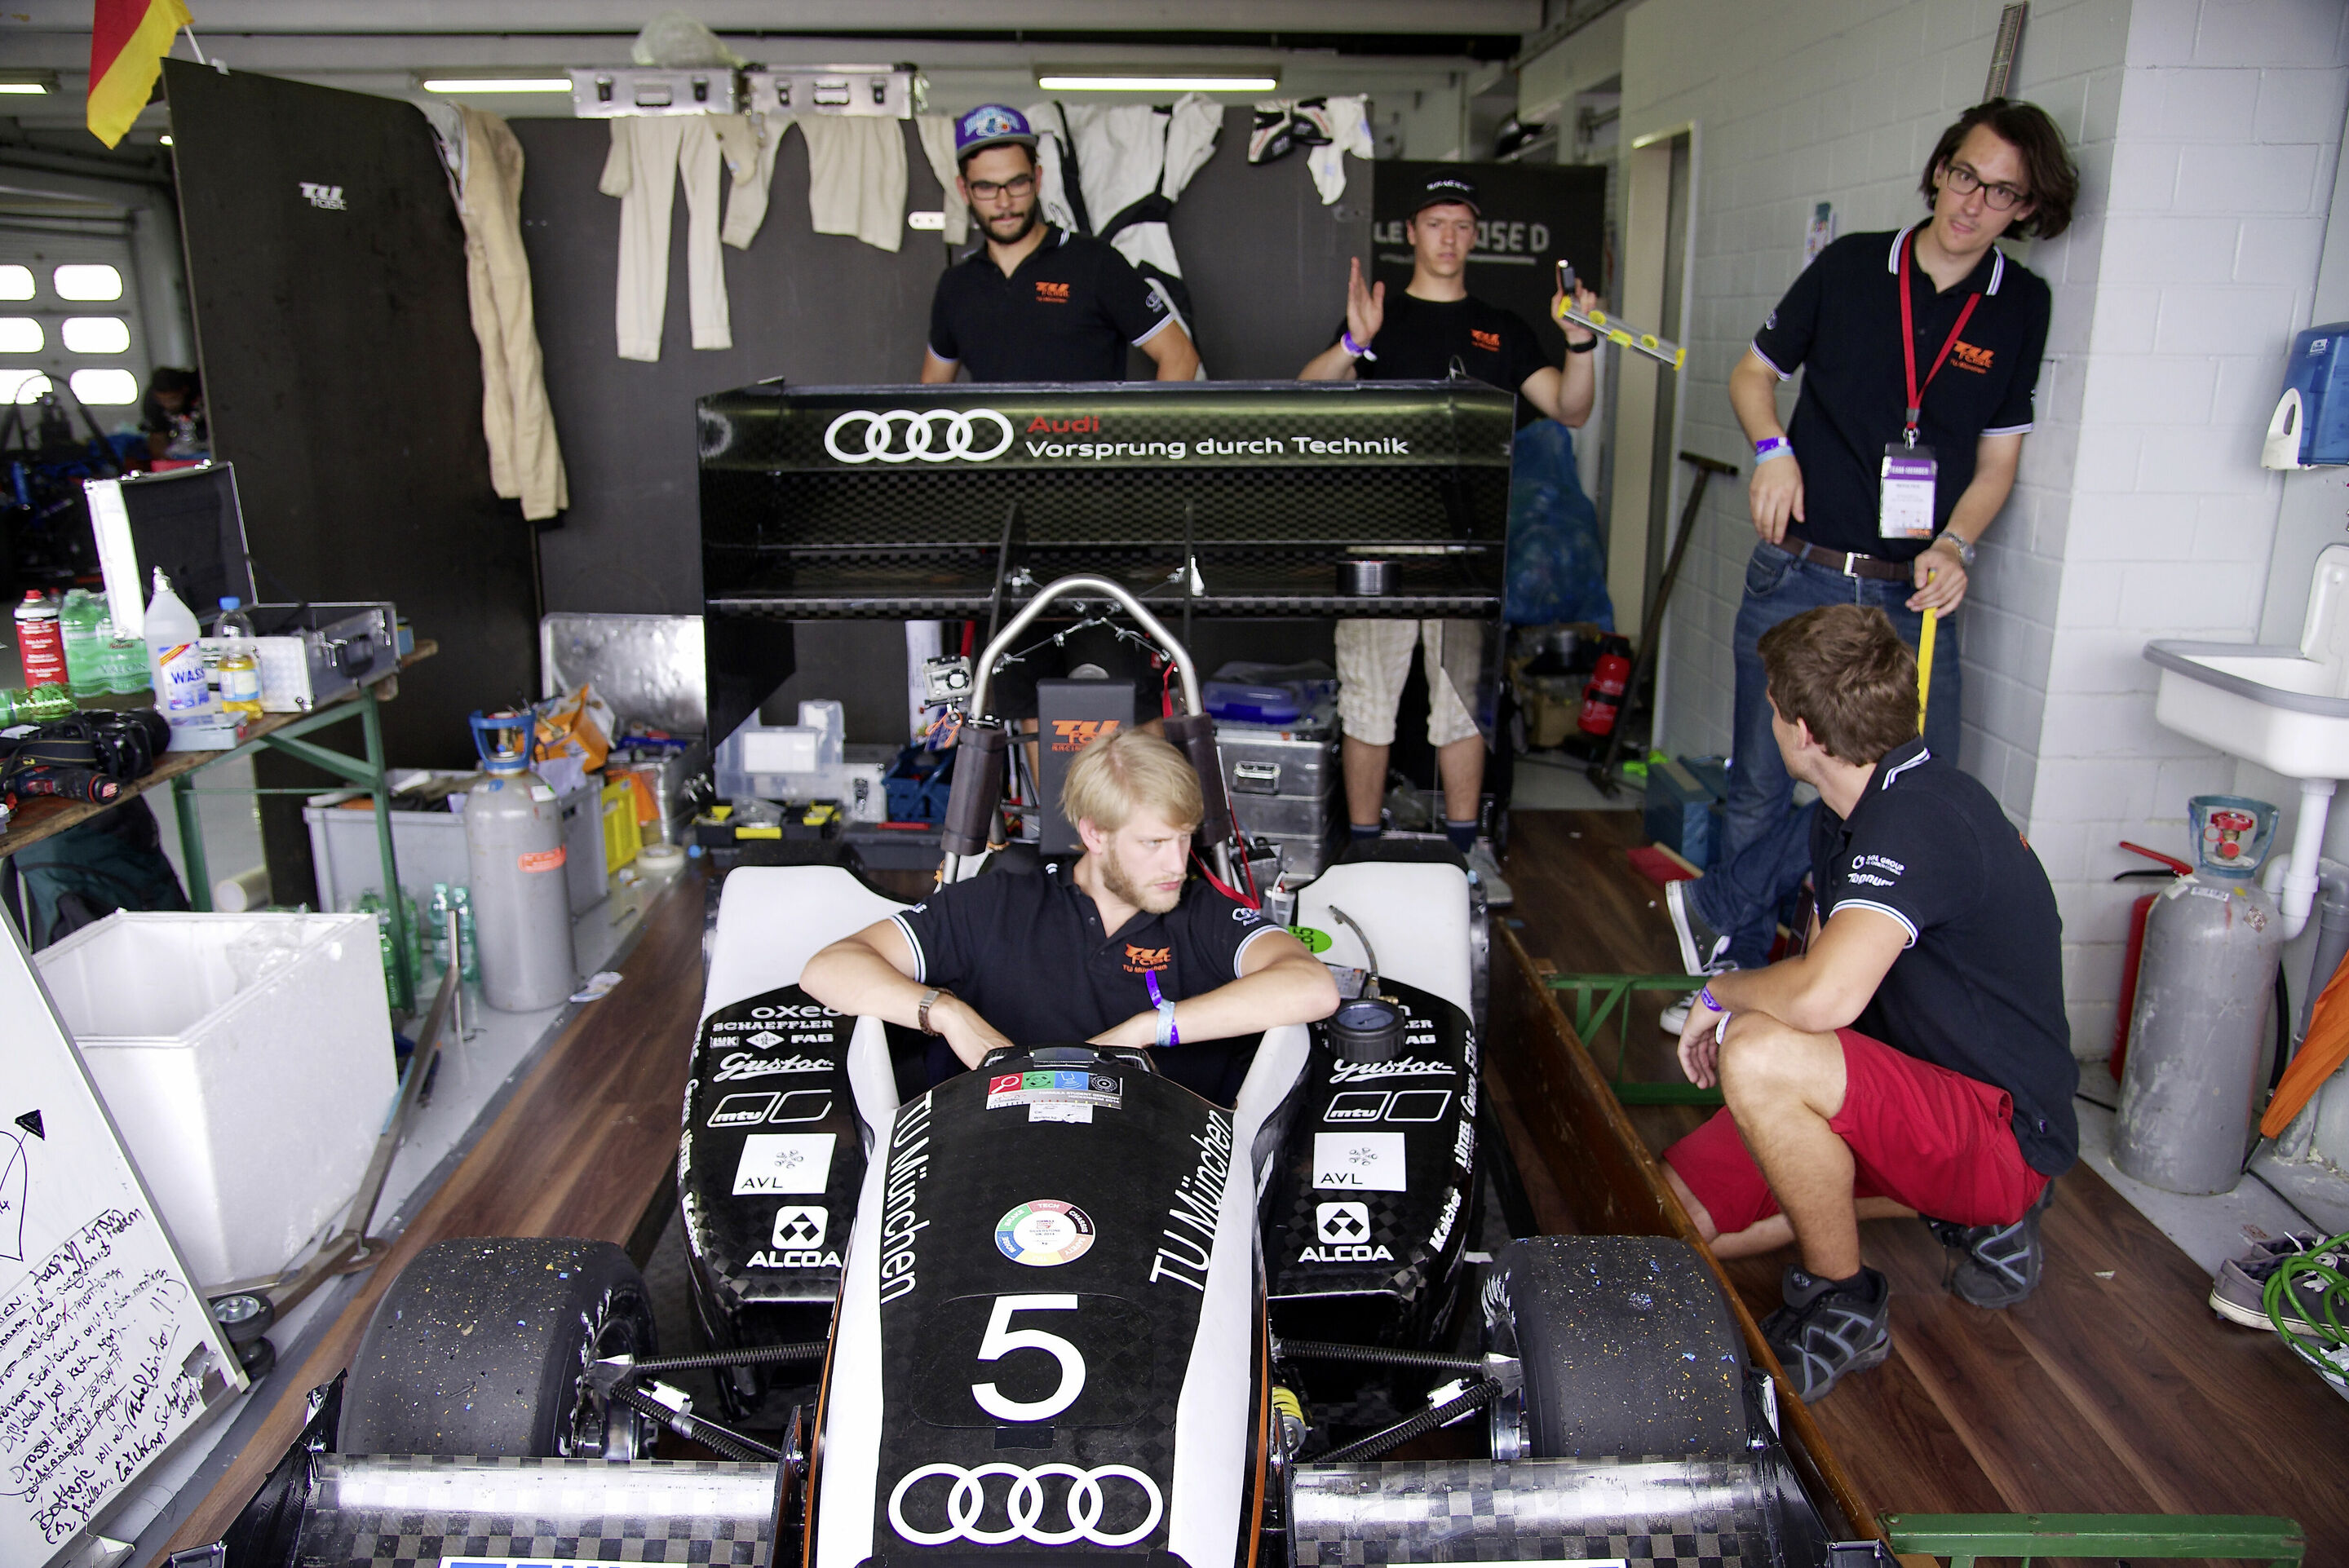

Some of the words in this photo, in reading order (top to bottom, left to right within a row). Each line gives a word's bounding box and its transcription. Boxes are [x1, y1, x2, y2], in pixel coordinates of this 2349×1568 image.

[1027, 414, 1100, 435] Audi
[1025, 439, 1187, 461] Vorsprung
[1198, 436, 1282, 456] durch
[1291, 435, 1410, 455] Technik
[1051, 720, 1120, 735] TU
[712, 1020, 834, 1032] SCHAEFFLER
[790, 1033, 834, 1044] FAG
[1405, 1035, 1436, 1045] AG
[714, 1111, 763, 1122] mtu
[894, 1090, 932, 1149] TU
[1329, 1109, 1378, 1118] mtu
[741, 1177, 784, 1189] AVL
[1169, 1110, 1235, 1240] München
[1320, 1173, 1363, 1185] AVL
[880, 1133, 931, 1304] München
[1068, 1210, 1089, 1234] CHASSIS
[1429, 1188, 1462, 1253] Kalcher
[1002, 1236, 1017, 1253] NOISE
[1064, 1236, 1087, 1257] SAFETY
[1298, 1244, 1395, 1263] ALCOA
[746, 1250, 843, 1269] ALCOA
[1149, 1228, 1210, 1292] TU
[971, 1293, 1087, 1422] 5
